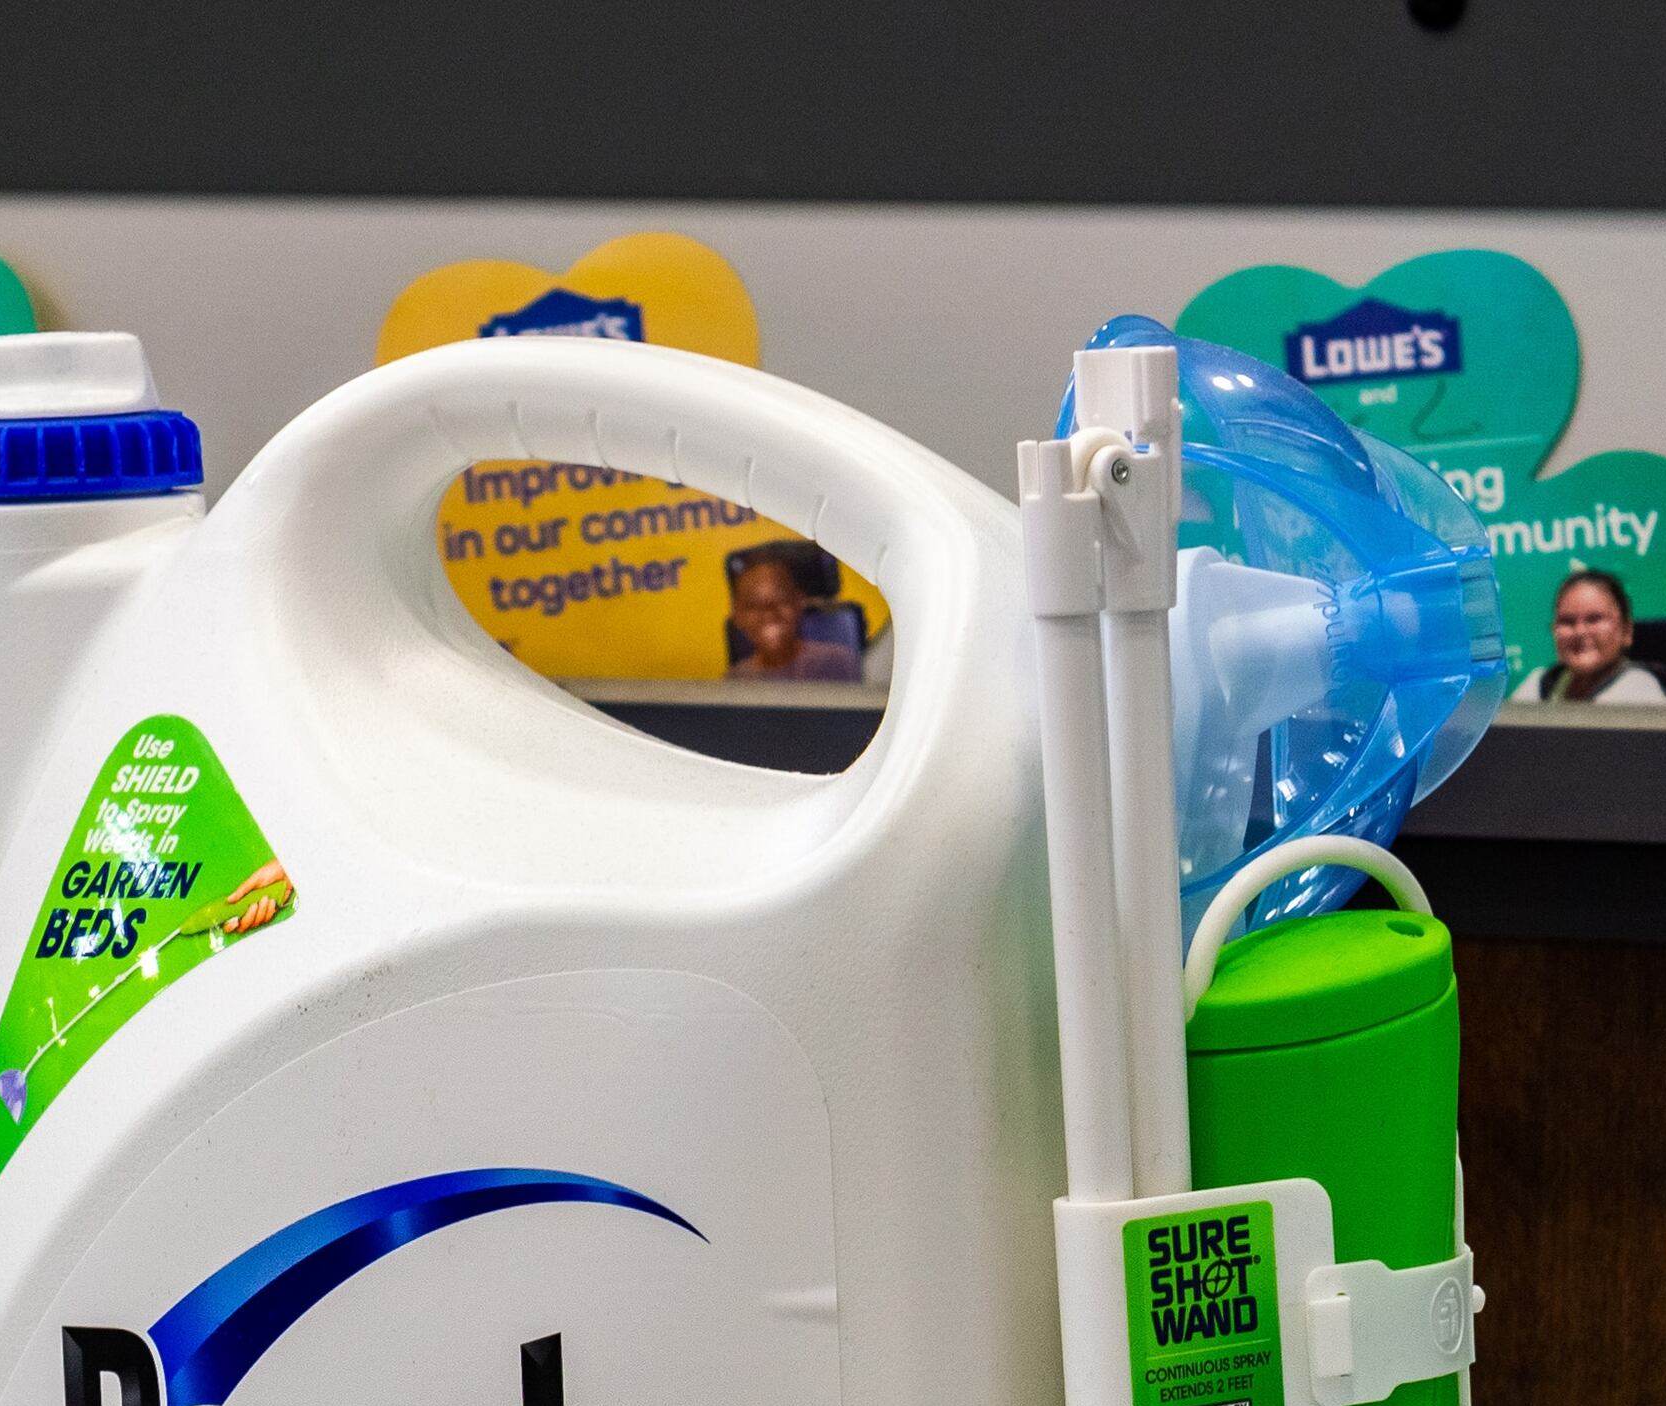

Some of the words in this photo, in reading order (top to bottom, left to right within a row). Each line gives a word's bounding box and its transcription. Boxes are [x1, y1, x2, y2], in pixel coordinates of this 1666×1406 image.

[1301, 326, 1445, 379] LOWE'S
[1360, 385, 1397, 405] and
[445, 523, 483, 560] in
[494, 517, 568, 555] our
[580, 498, 755, 544] commu
[489, 556, 688, 616] together
[133, 734, 175, 759] Use
[111, 766, 199, 794] SHIELD
[125, 798, 188, 827] Spray
[157, 831, 179, 854] in
[61, 861, 203, 900] GARDEN
[35, 908, 147, 959] BEDS
[1148, 1215, 1249, 1267] SURE
[1150, 1254, 1251, 1309] SHOT
[1151, 1296, 1258, 1347] WAND
[1145, 1357, 1230, 1384] CONTINUOUS
[1234, 1351, 1271, 1369] SPRAY
[1160, 1381, 1213, 1403] EXTENDS
[1217, 1381, 1225, 1394] 2
[1228, 1375, 1254, 1392] FEET
